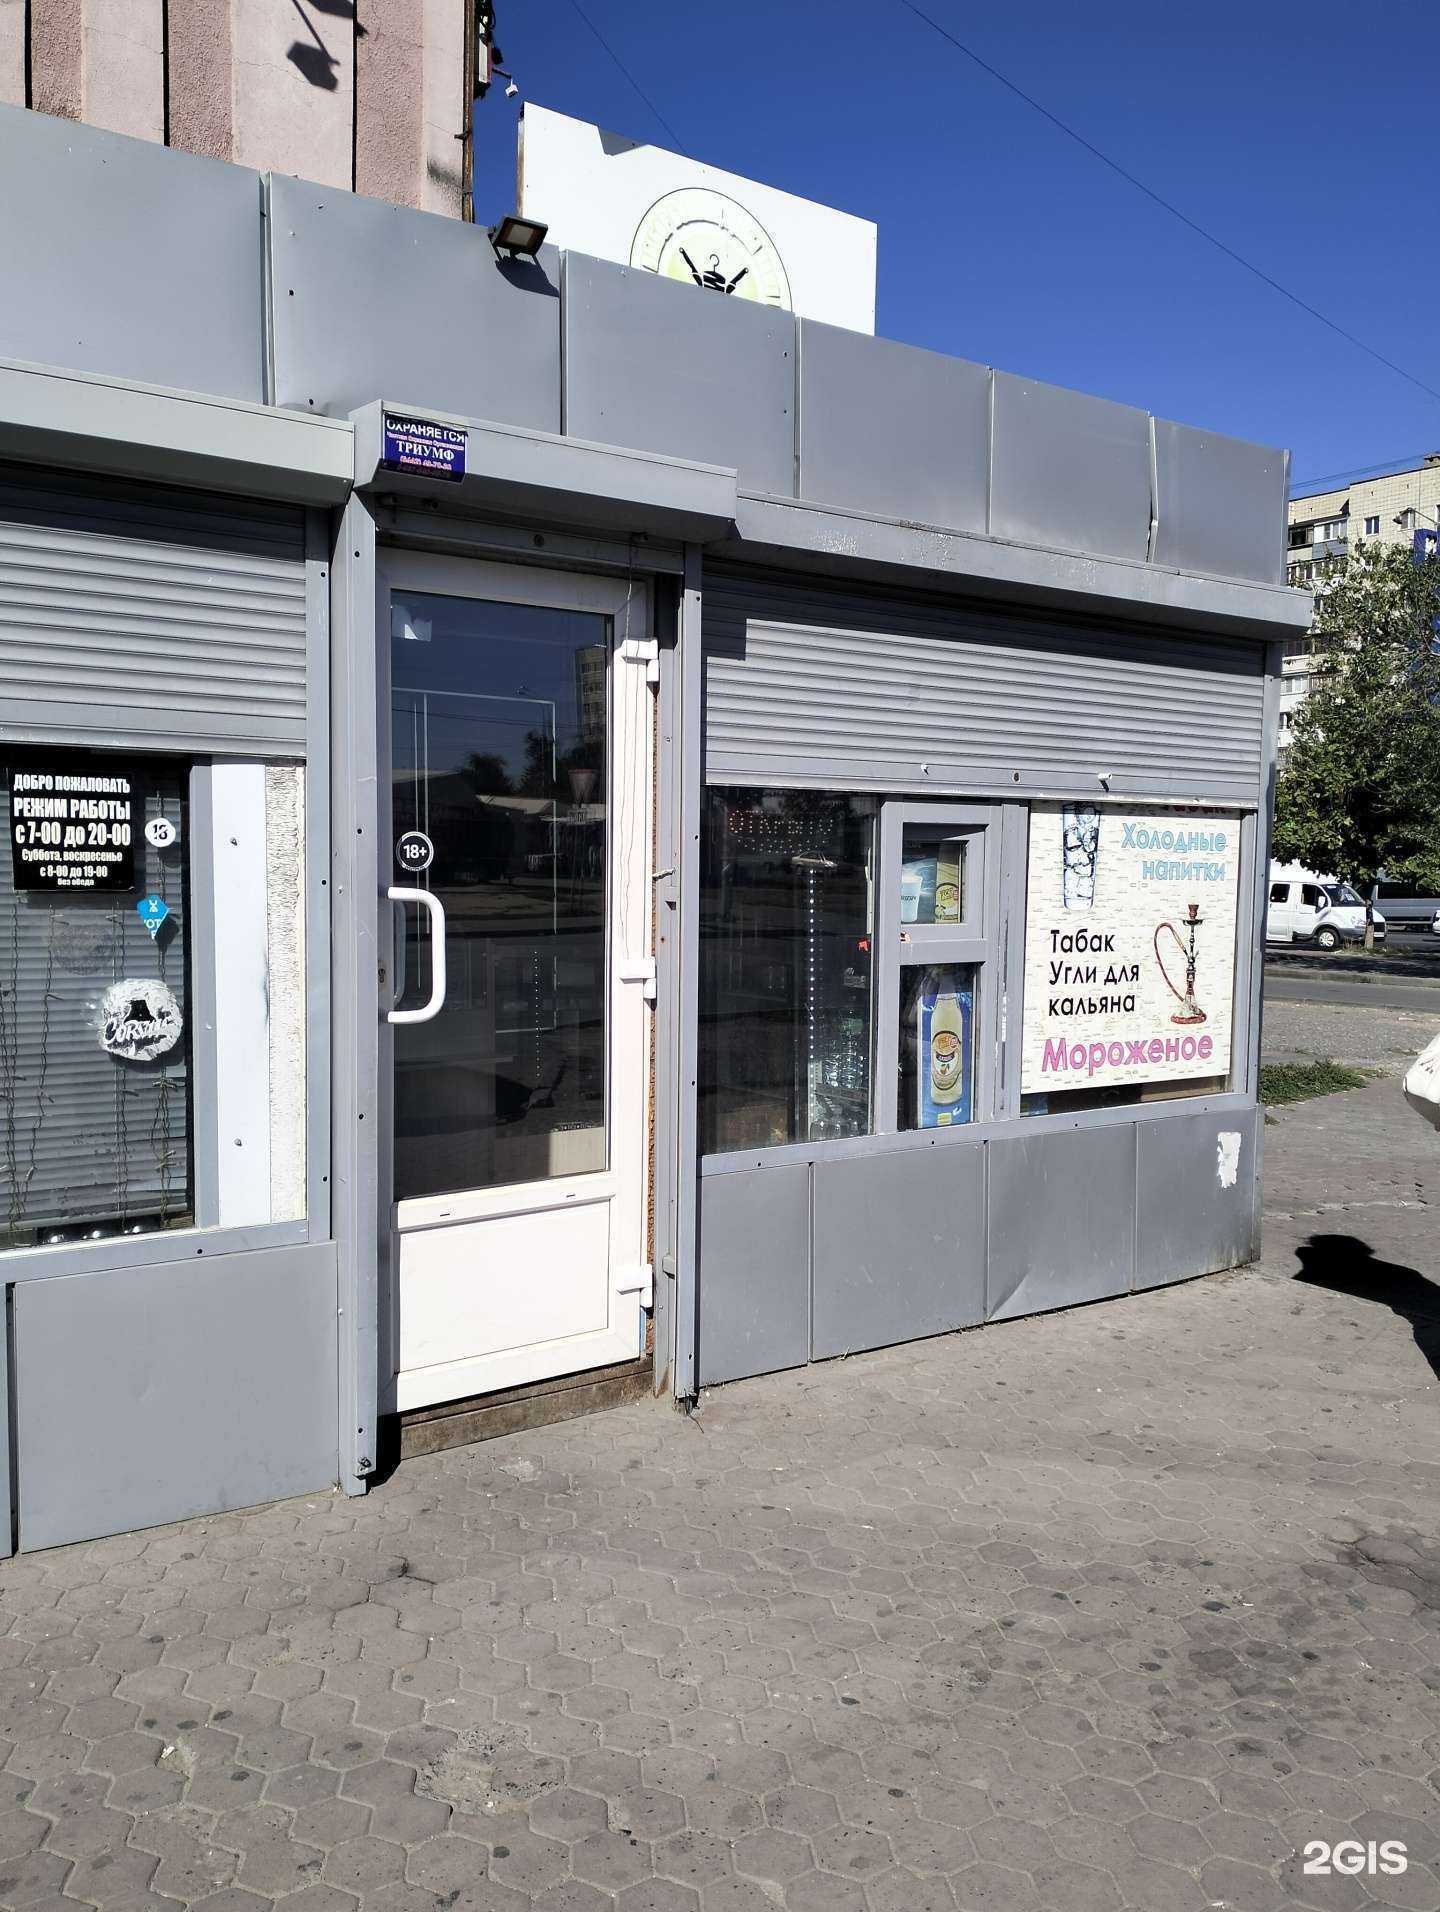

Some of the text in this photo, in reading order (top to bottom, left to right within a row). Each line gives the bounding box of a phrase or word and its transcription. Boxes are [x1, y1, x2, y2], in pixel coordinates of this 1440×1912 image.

[386, 419, 465, 443] ОХРАНЯЕТСЯ
[396, 440, 455, 461] ТРИУМФ
[13, 774, 131, 793] ДОБРО ПОЖАЛОВАТЬ
[13, 797, 131, 820] РЕЖИМ РАБОТЫ
[27, 821, 61, 845] 7-00
[64, 826, 86, 848] до
[88, 822, 131, 846] 20-00
[1121, 822, 1227, 853] Холодные
[63, 850, 123, 862] воскресенье
[403, 844, 427, 859] 18+
[47, 865, 69, 877] 8-00
[69, 867, 83, 879] до
[83, 865, 108, 878] 19-00
[1142, 860, 1226, 881] напитки
[1050, 928, 1116, 953] Табак
[1049, 961, 1140, 986] Угли для
[1048, 994, 1136, 1017] кальяна
[1041, 1035, 1214, 1077] Мороженое
